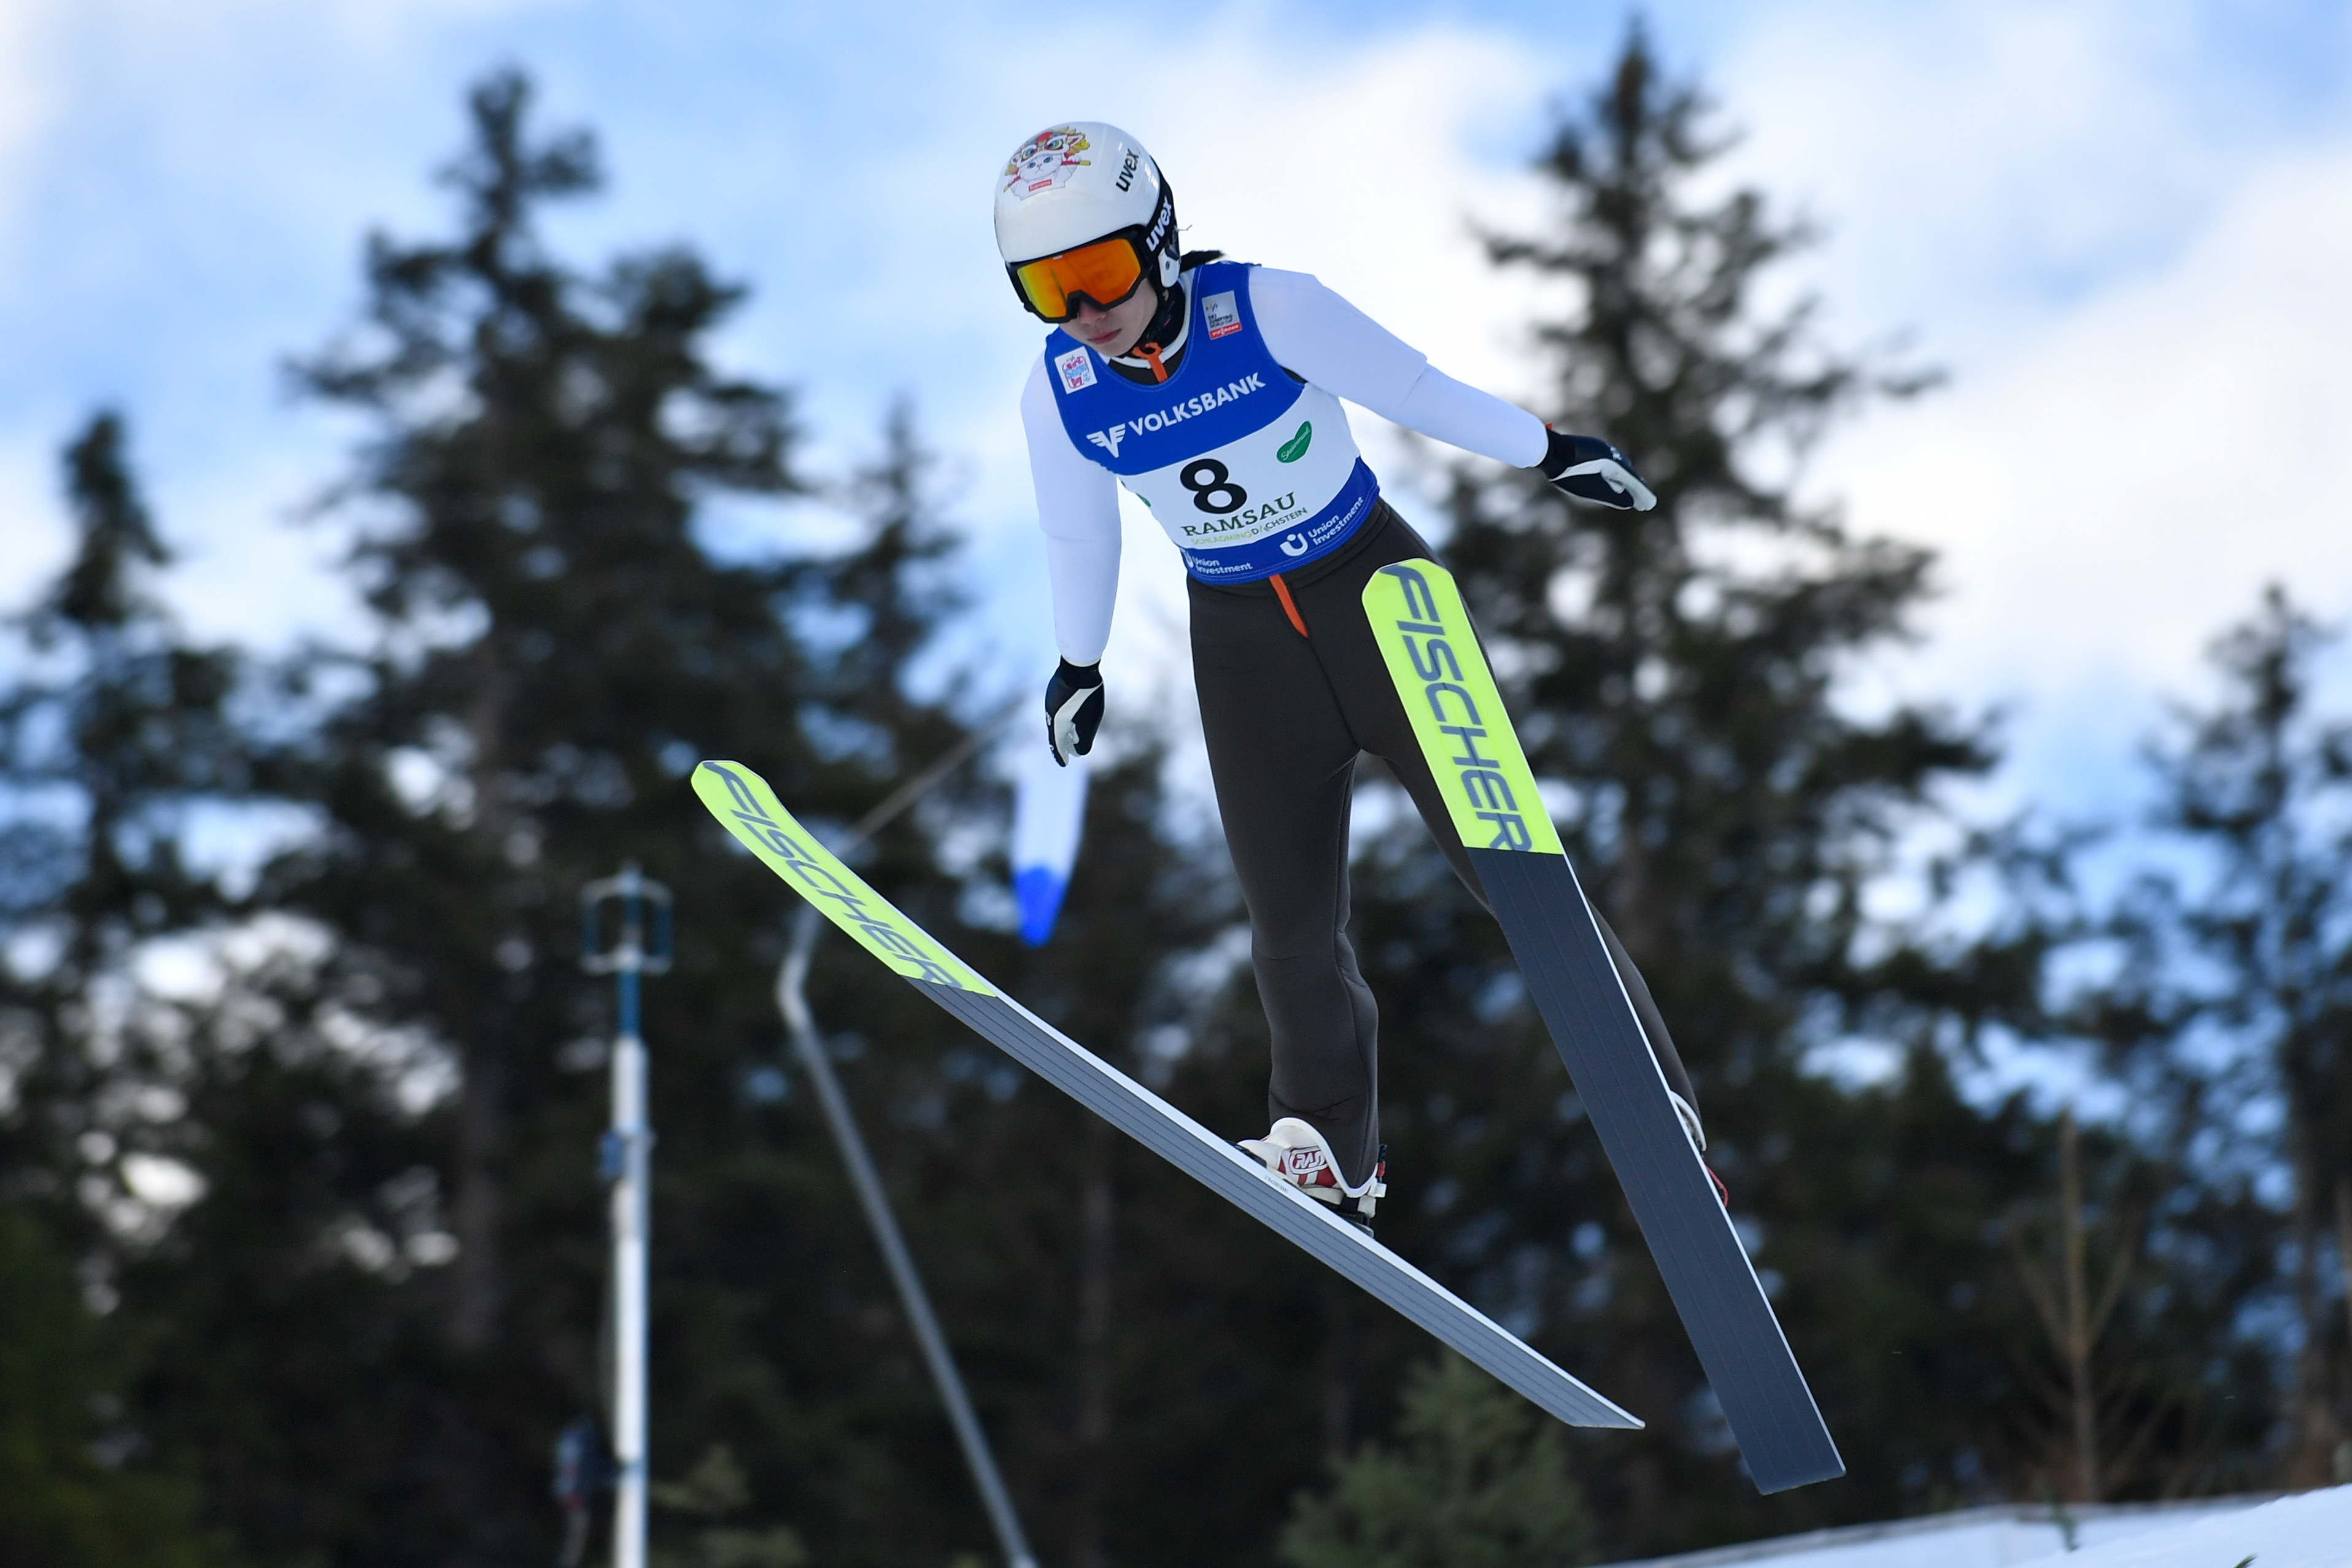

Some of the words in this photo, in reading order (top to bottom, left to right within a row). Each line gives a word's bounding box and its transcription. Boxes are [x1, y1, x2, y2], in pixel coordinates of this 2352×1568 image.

[1115, 147, 1140, 193] uvex
[1145, 196, 1172, 252] uvex
[1129, 372, 1267, 436] VOLKSBANK
[1180, 458, 1247, 514] 8
[1180, 492, 1296, 536] RAMSAU
[1307, 514, 1340, 538] Union
[1312, 496, 1364, 546] Investment
[1191, 555, 1220, 566] Union
[1379, 564, 1533, 852] FISCHER
[702, 762, 964, 991] FISCHER
